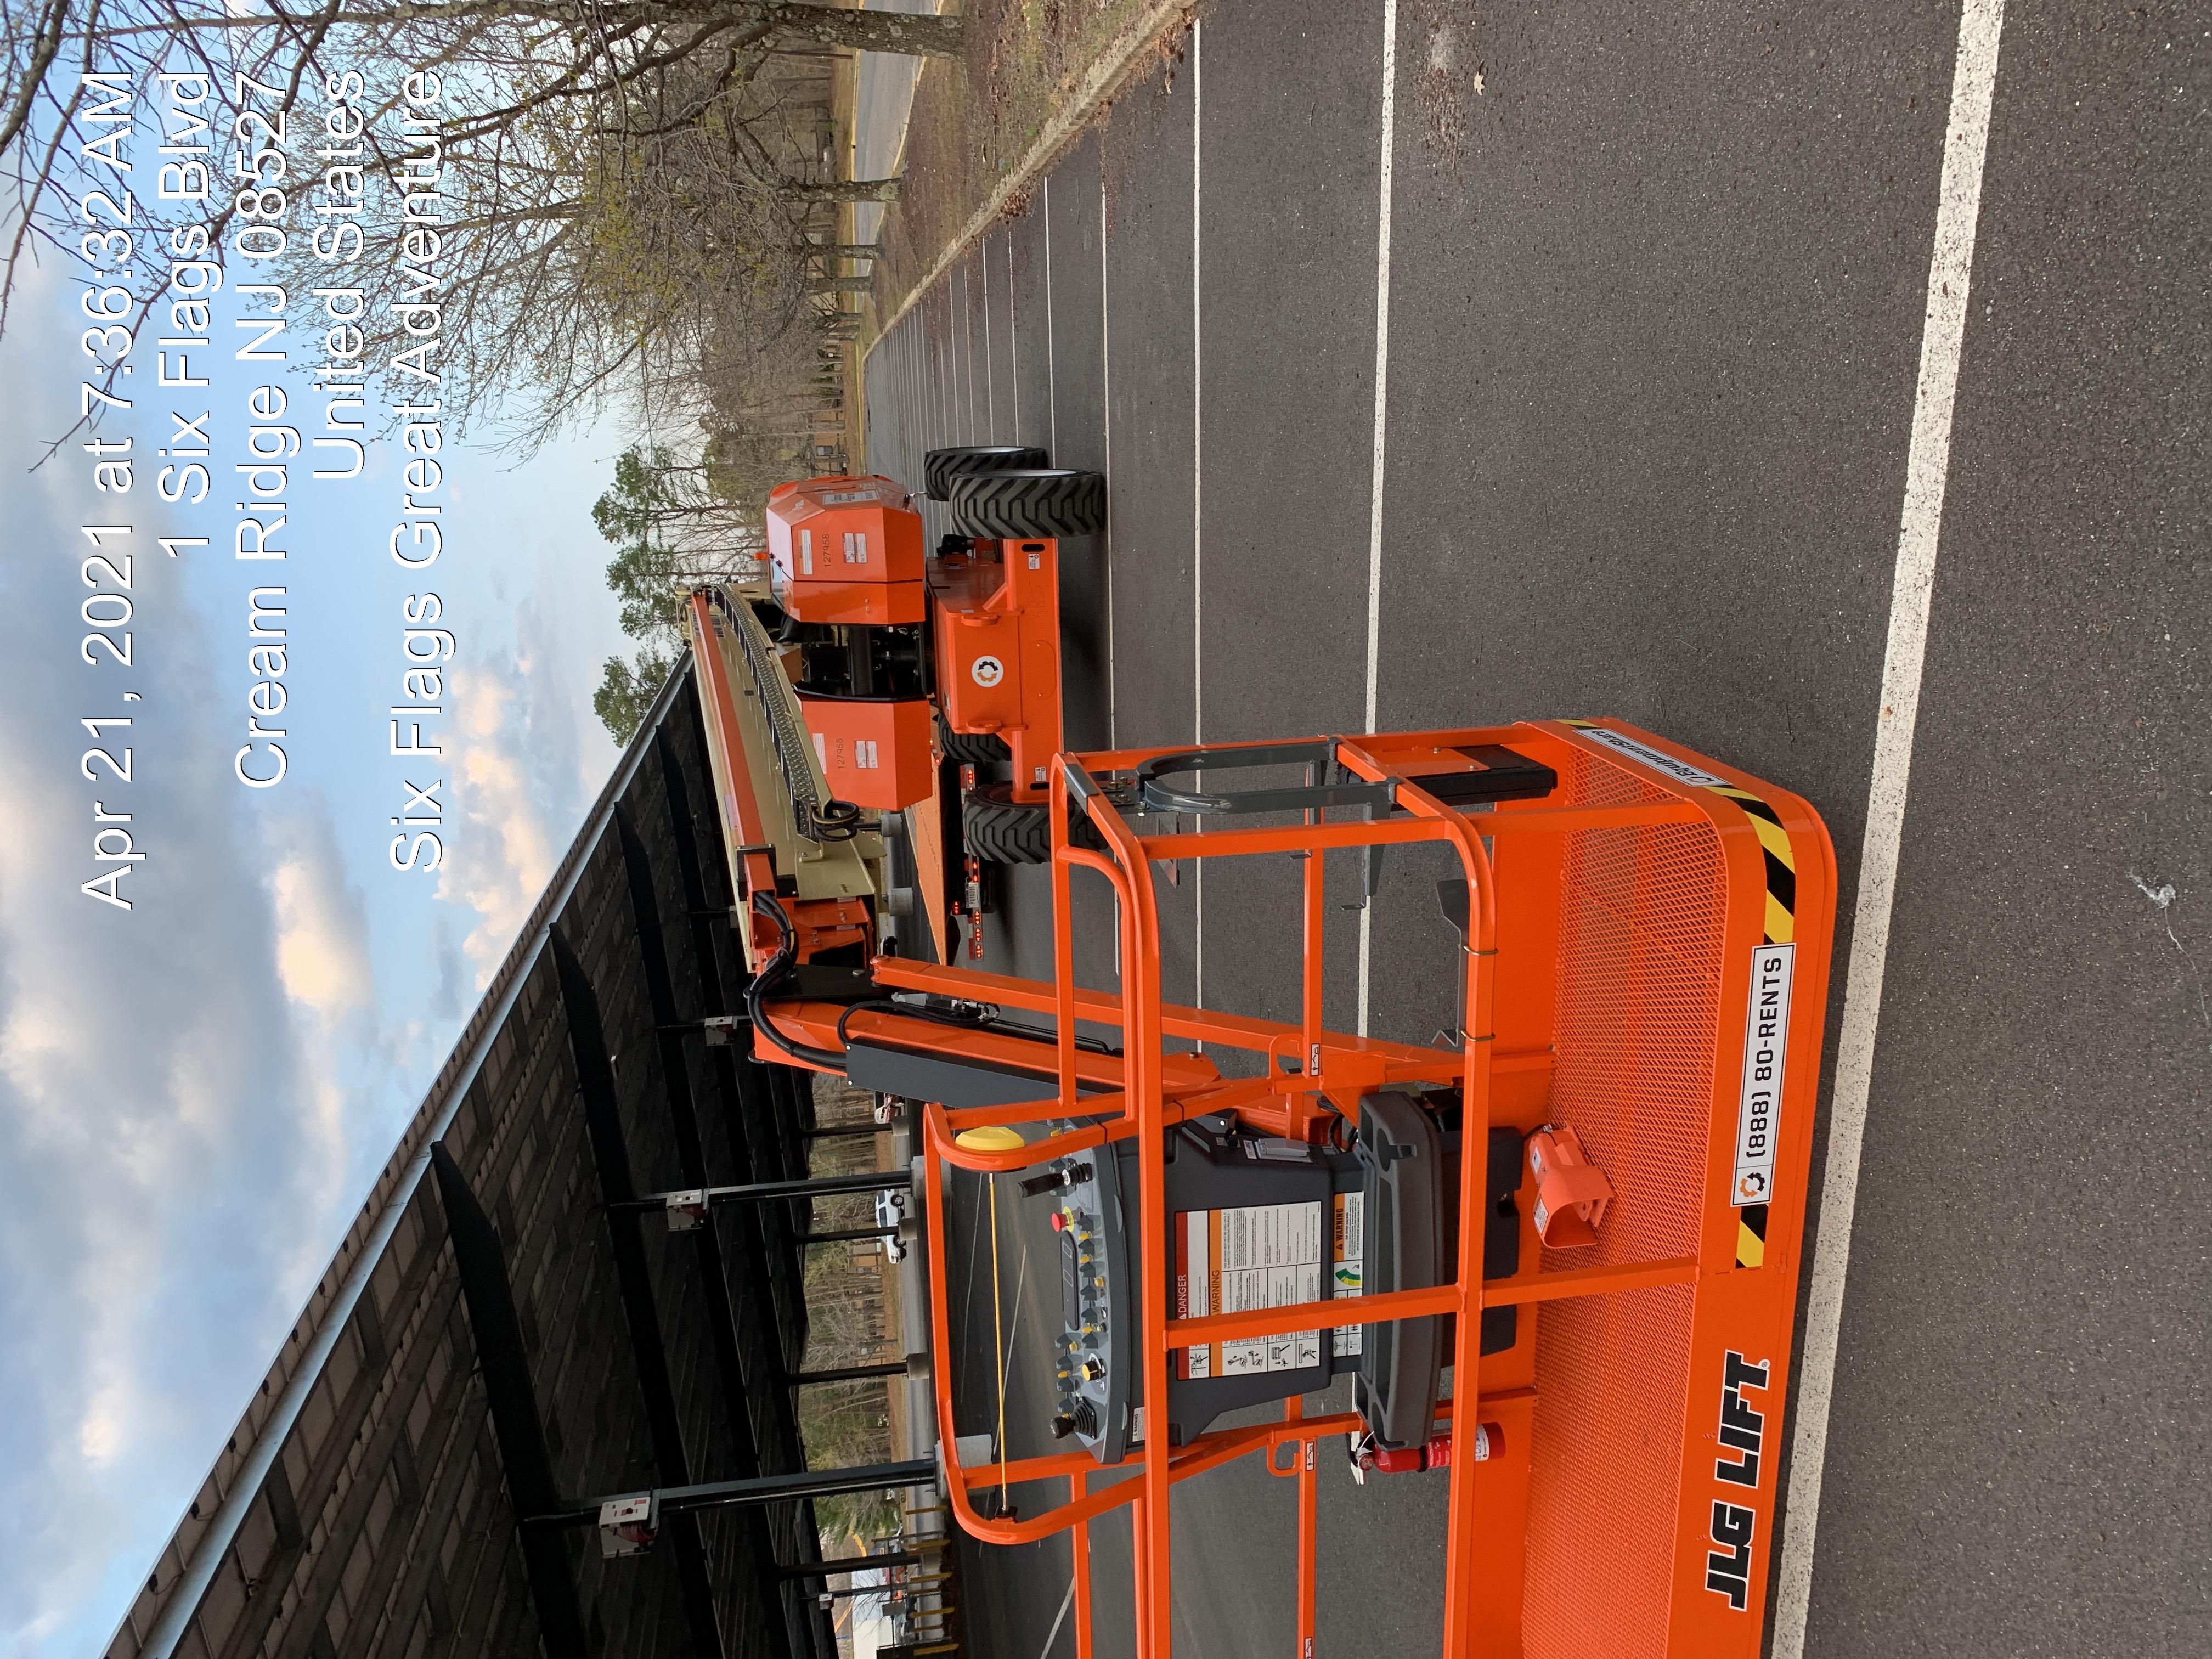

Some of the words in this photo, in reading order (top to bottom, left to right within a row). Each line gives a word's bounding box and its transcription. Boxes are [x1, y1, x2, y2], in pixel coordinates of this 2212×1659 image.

[823, 534, 831, 567] 127958
[836, 738, 845, 769] 127958
[1592, 730, 1698, 776] EquipmentShare
[1754, 957, 1782, 1081] 80-RENTS
[1746, 1091, 1771, 1158] (888)
[1335, 1208, 1344, 1241] WARNING
[1178, 1274, 1187, 1313] DANGER
[1211, 1269, 1220, 1313] WARNING
[1714, 1349, 1770, 1488] LIFT
[1705, 1499, 1755, 1611] JLG
